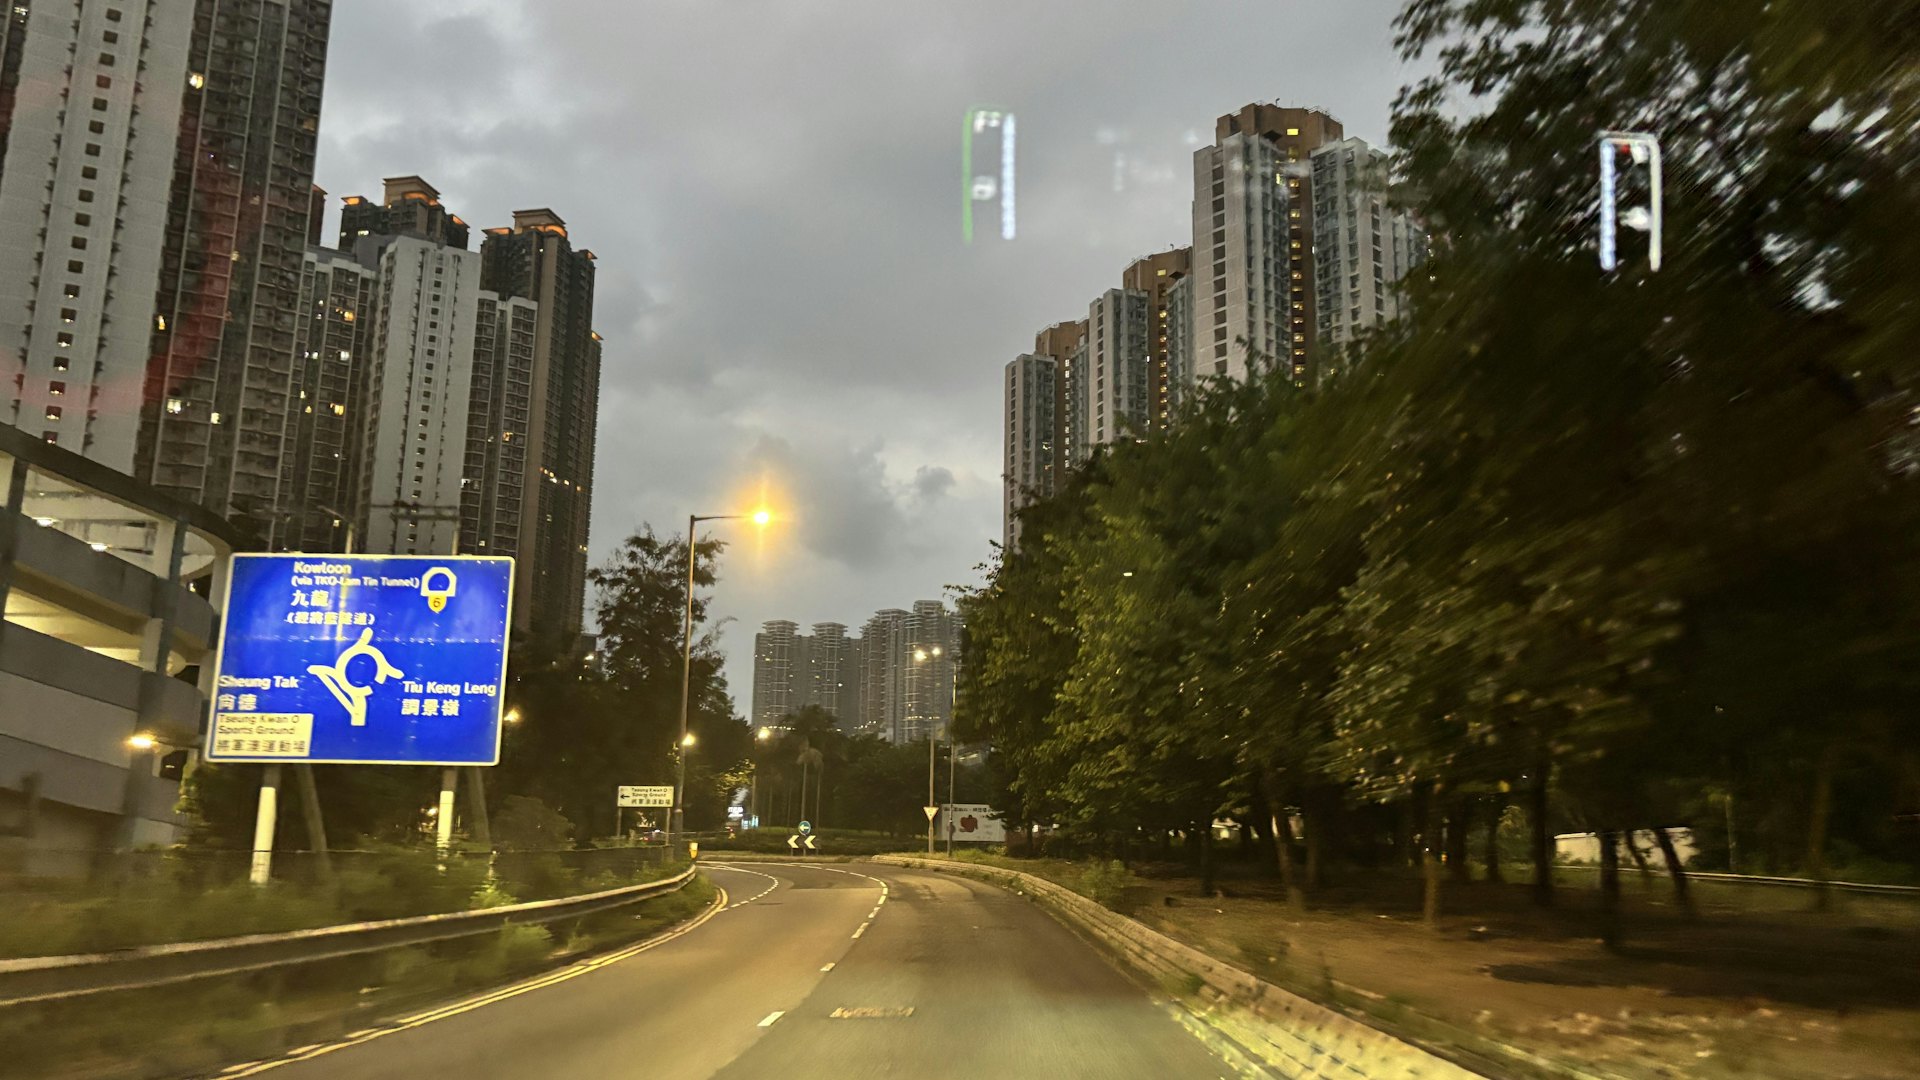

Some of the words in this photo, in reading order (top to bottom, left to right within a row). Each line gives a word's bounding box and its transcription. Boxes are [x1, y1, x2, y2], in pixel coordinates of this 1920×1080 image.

[293, 561, 352, 575] Kowloon
[291, 575, 313, 587] (via
[363, 576, 379, 587] Tin
[380, 576, 420, 588] Tunnel)
[290, 590, 330, 607] 九龍
[433, 597, 441, 608] 6
[218, 675, 271, 690] Sheung
[273, 675, 299, 688] Tak
[402, 681, 423, 693] Tiu
[426, 681, 461, 697] Keng
[464, 682, 497, 697] Leng
[218, 693, 257, 710] 尚德
[219, 714, 257, 725] Tseung
[260, 715, 288, 723] Kwan
[291, 715, 300, 724] O
[218, 725, 253, 735] Sports
[256, 725, 296, 735] Ground
